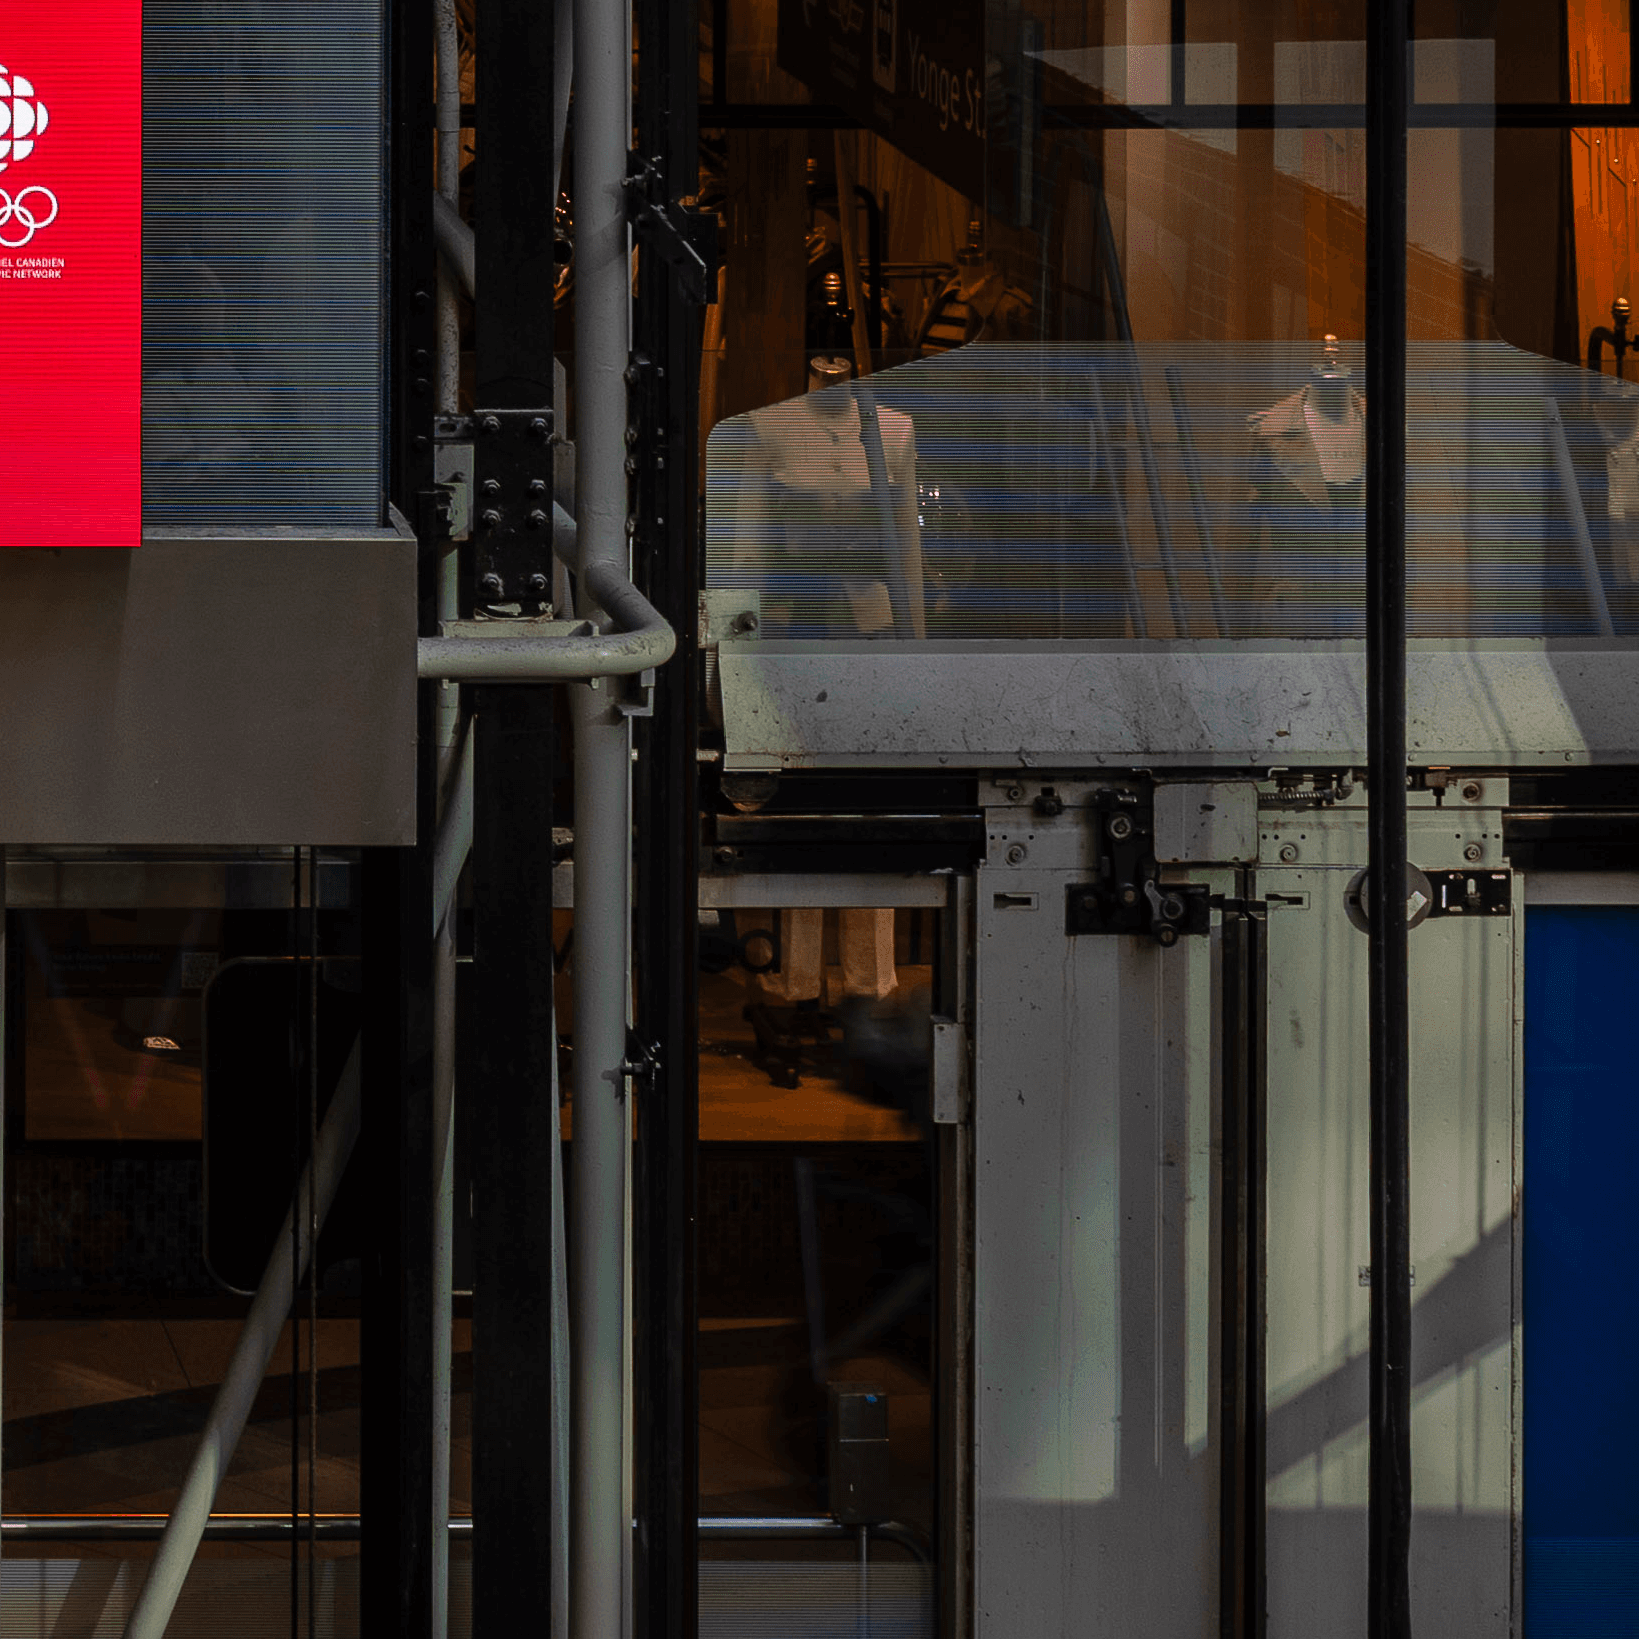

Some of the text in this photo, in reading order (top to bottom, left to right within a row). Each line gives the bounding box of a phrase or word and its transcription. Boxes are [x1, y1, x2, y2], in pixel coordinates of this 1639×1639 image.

[907, 28, 960, 131] Yonge
[16, 257, 65, 268] CANADIEN
[12, 268, 62, 279] NETWORK
